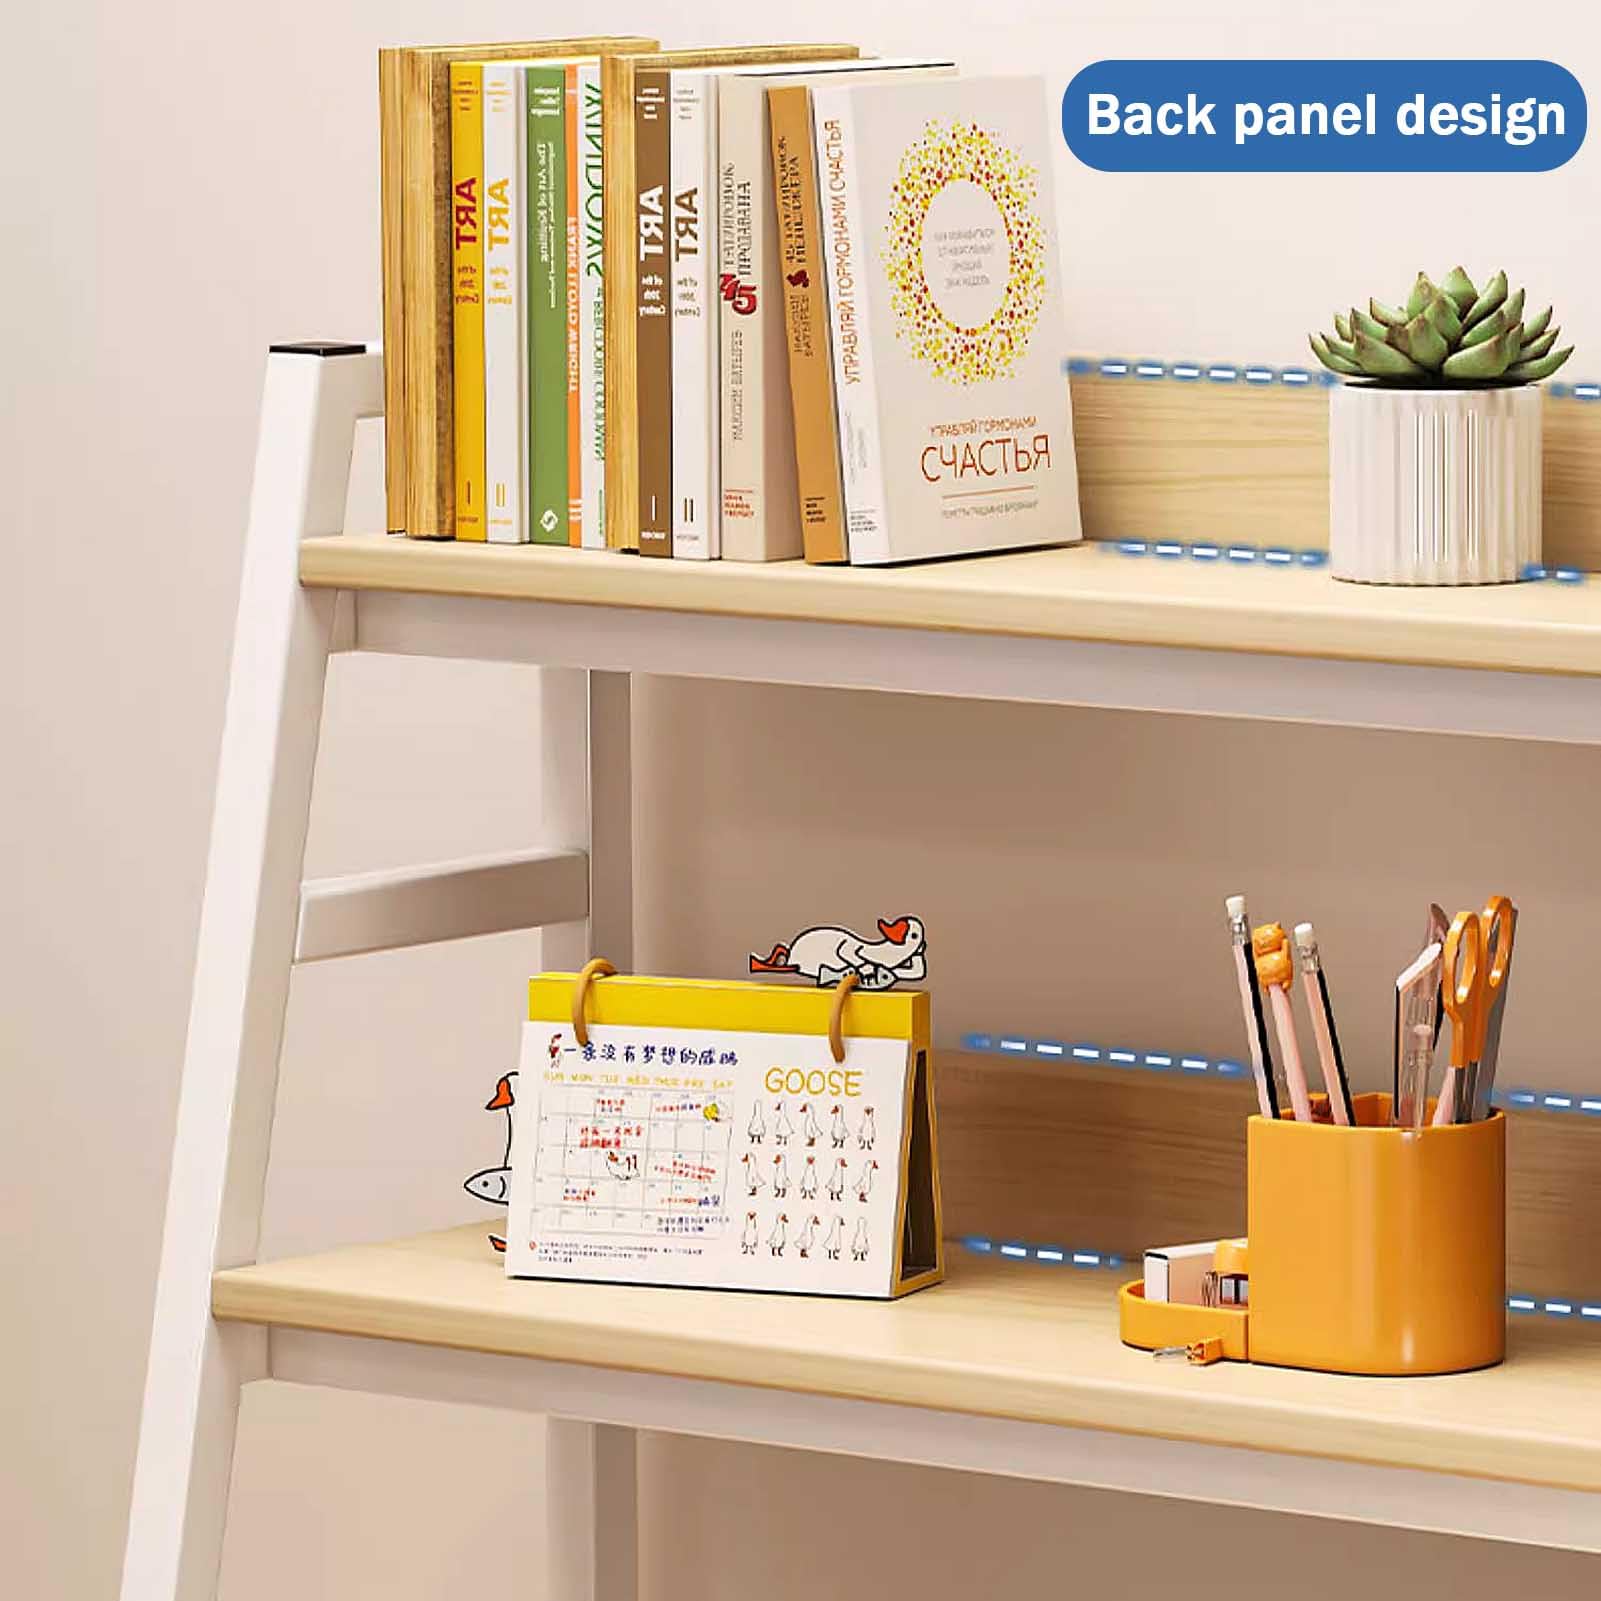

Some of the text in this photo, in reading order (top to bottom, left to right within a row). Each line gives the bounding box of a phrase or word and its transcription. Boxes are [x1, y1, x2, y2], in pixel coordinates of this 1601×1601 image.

[824, 119, 846, 192] СЧАСТЬЯ
[829, 195, 855, 298] ГОРМОНАМИ
[838, 300, 861, 385] УПРАВЛЯЙ
[921, 434, 1051, 482] СЧАСТЬЯ
[764, 1066, 865, 1097] GOOSE
